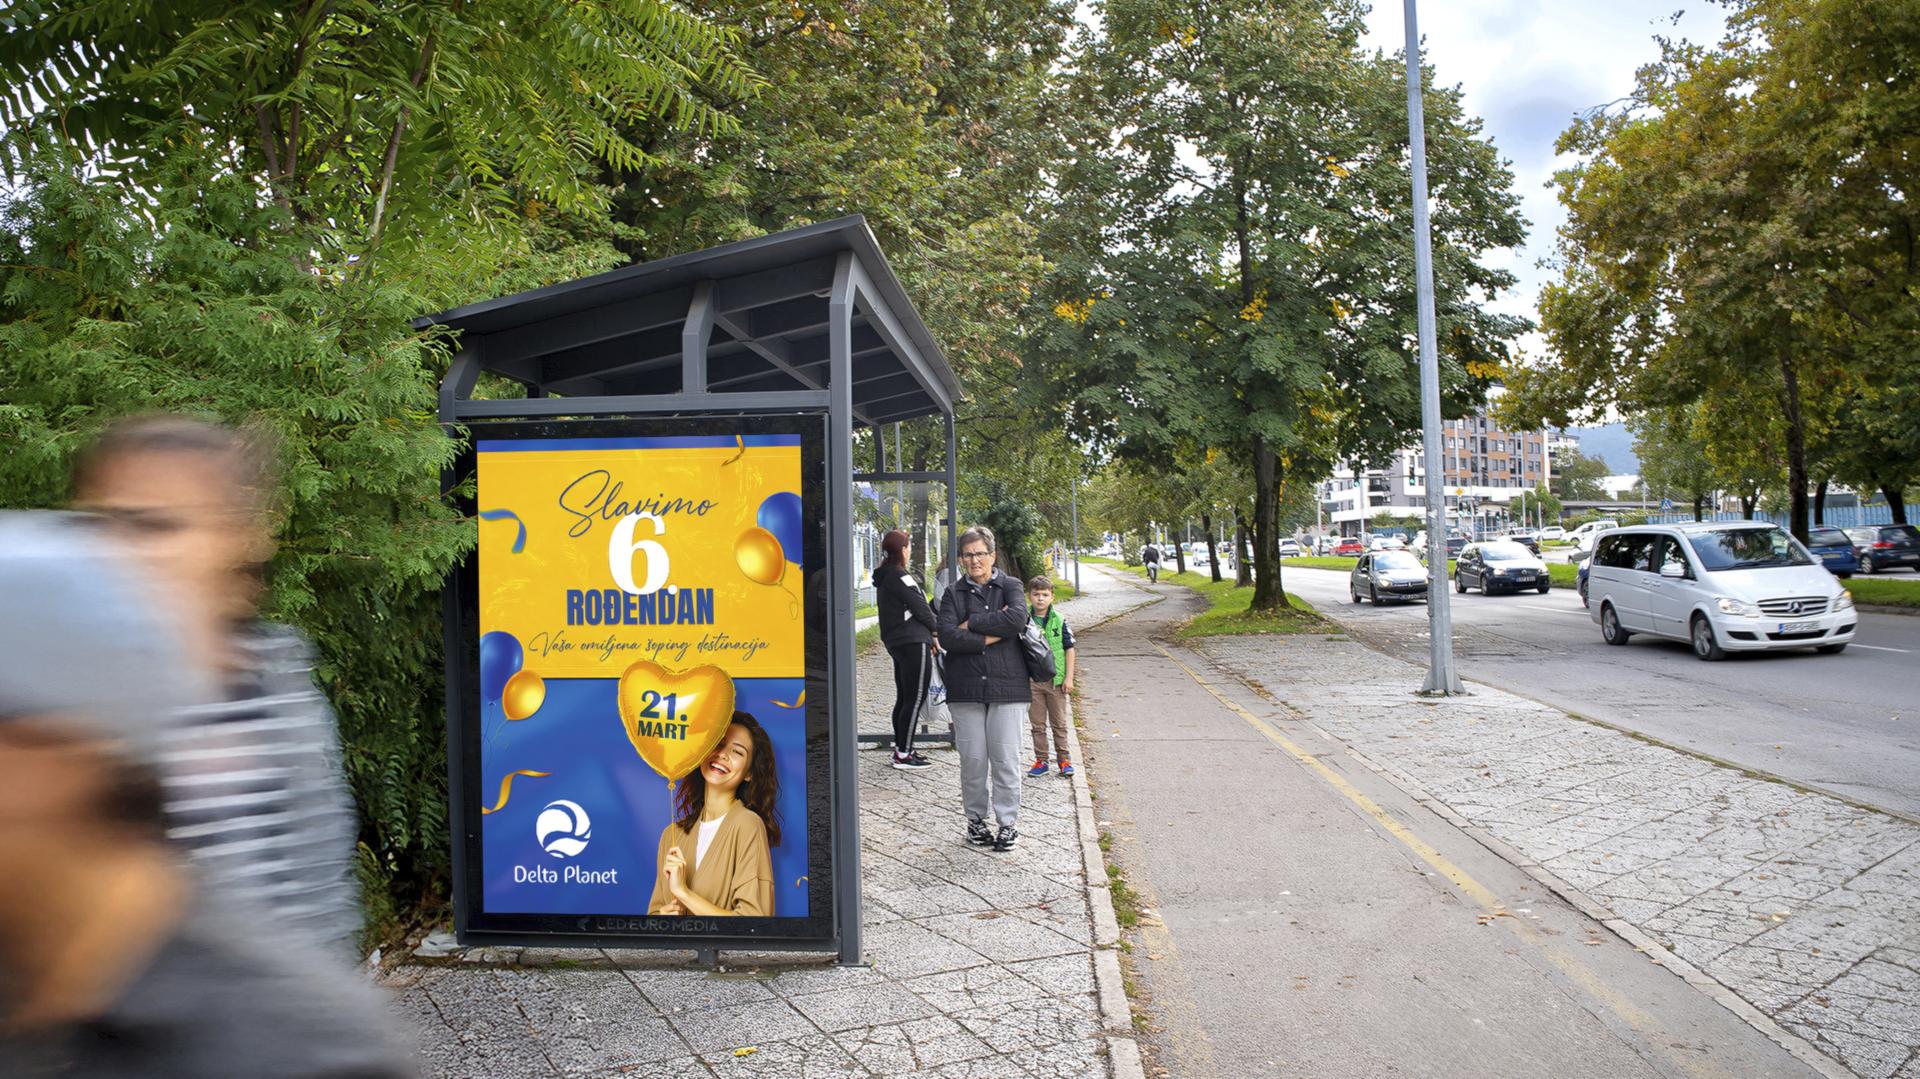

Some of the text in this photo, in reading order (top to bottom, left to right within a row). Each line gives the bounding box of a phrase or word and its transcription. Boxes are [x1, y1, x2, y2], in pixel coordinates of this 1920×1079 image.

[559, 469, 719, 538] Slavimo
[608, 511, 678, 595] 6.
[566, 588, 715, 626] ROĐENDAN
[528, 630, 770, 662] Vaša omiljena šoping destinacija
[640, 689, 688, 721] 21.
[637, 720, 690, 741] MART
[514, 864, 618, 884] Delta Planet
[629, 918, 669, 931] EURO
[672, 919, 719, 932] MEDIA
